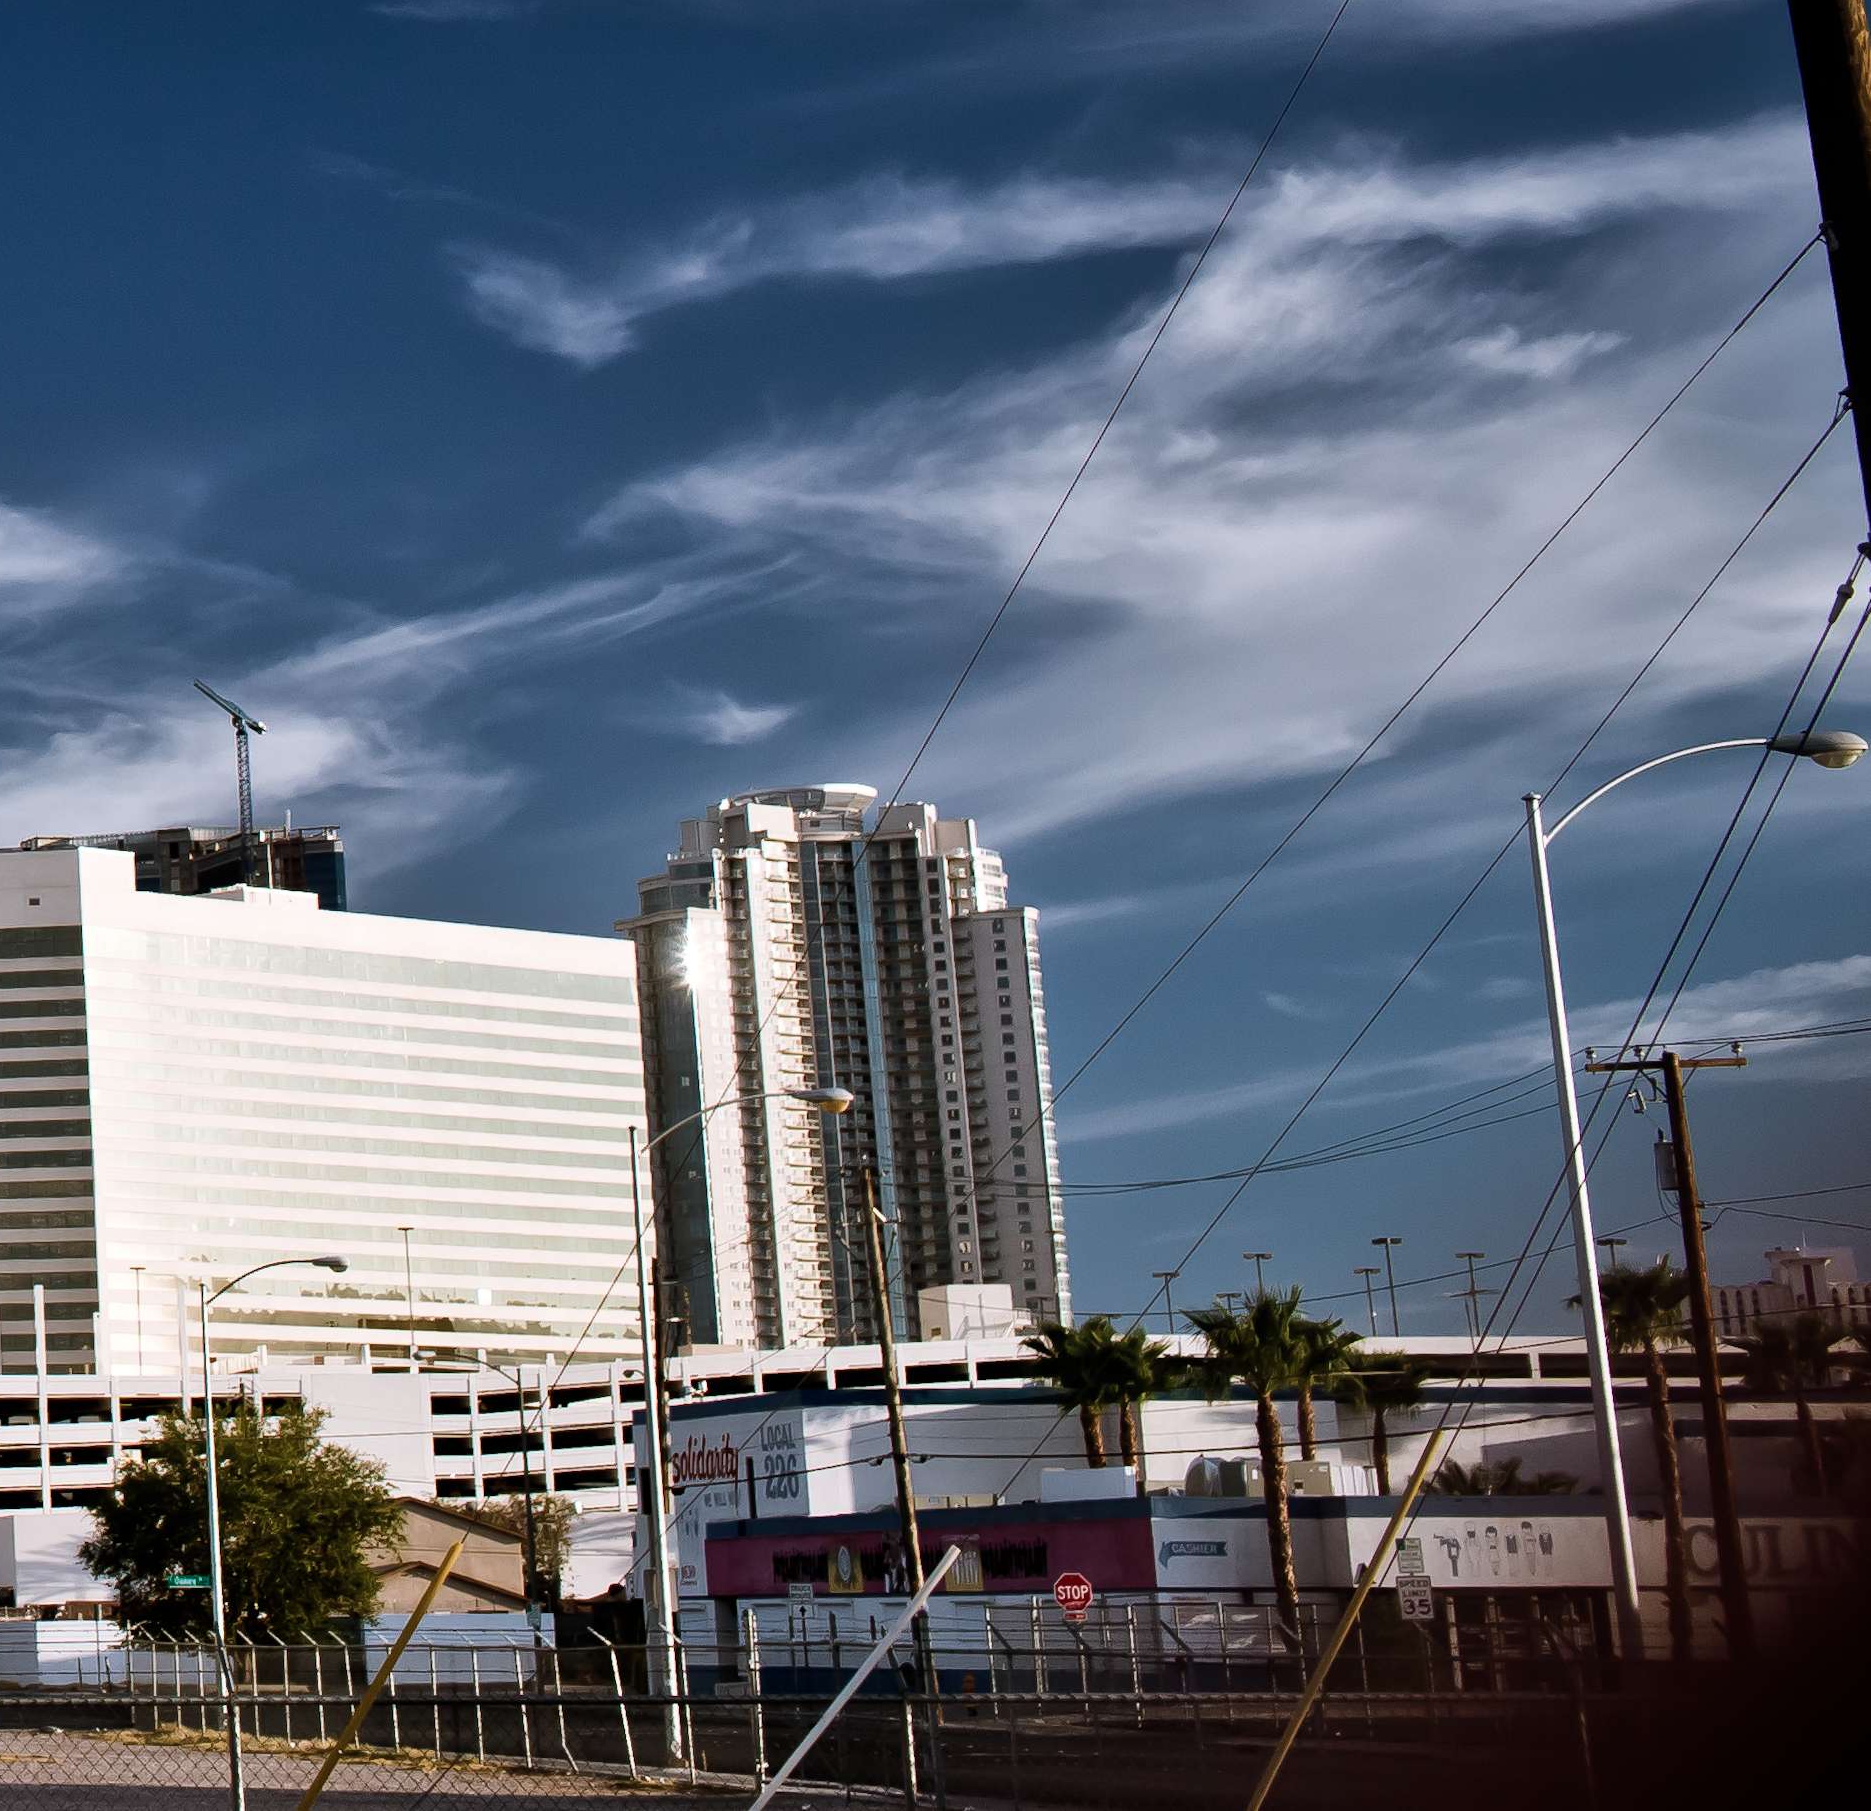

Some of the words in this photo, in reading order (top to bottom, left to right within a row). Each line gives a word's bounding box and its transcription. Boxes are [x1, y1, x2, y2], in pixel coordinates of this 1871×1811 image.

[759, 1421, 796, 1452] LOCAL
[671, 1432, 740, 1496] solidarity
[764, 1453, 800, 1500] 226
[1058, 1585, 1088, 1600] STOP
[1399, 1579, 1429, 1587] SPEED
[1403, 1598, 1431, 1615] 35
